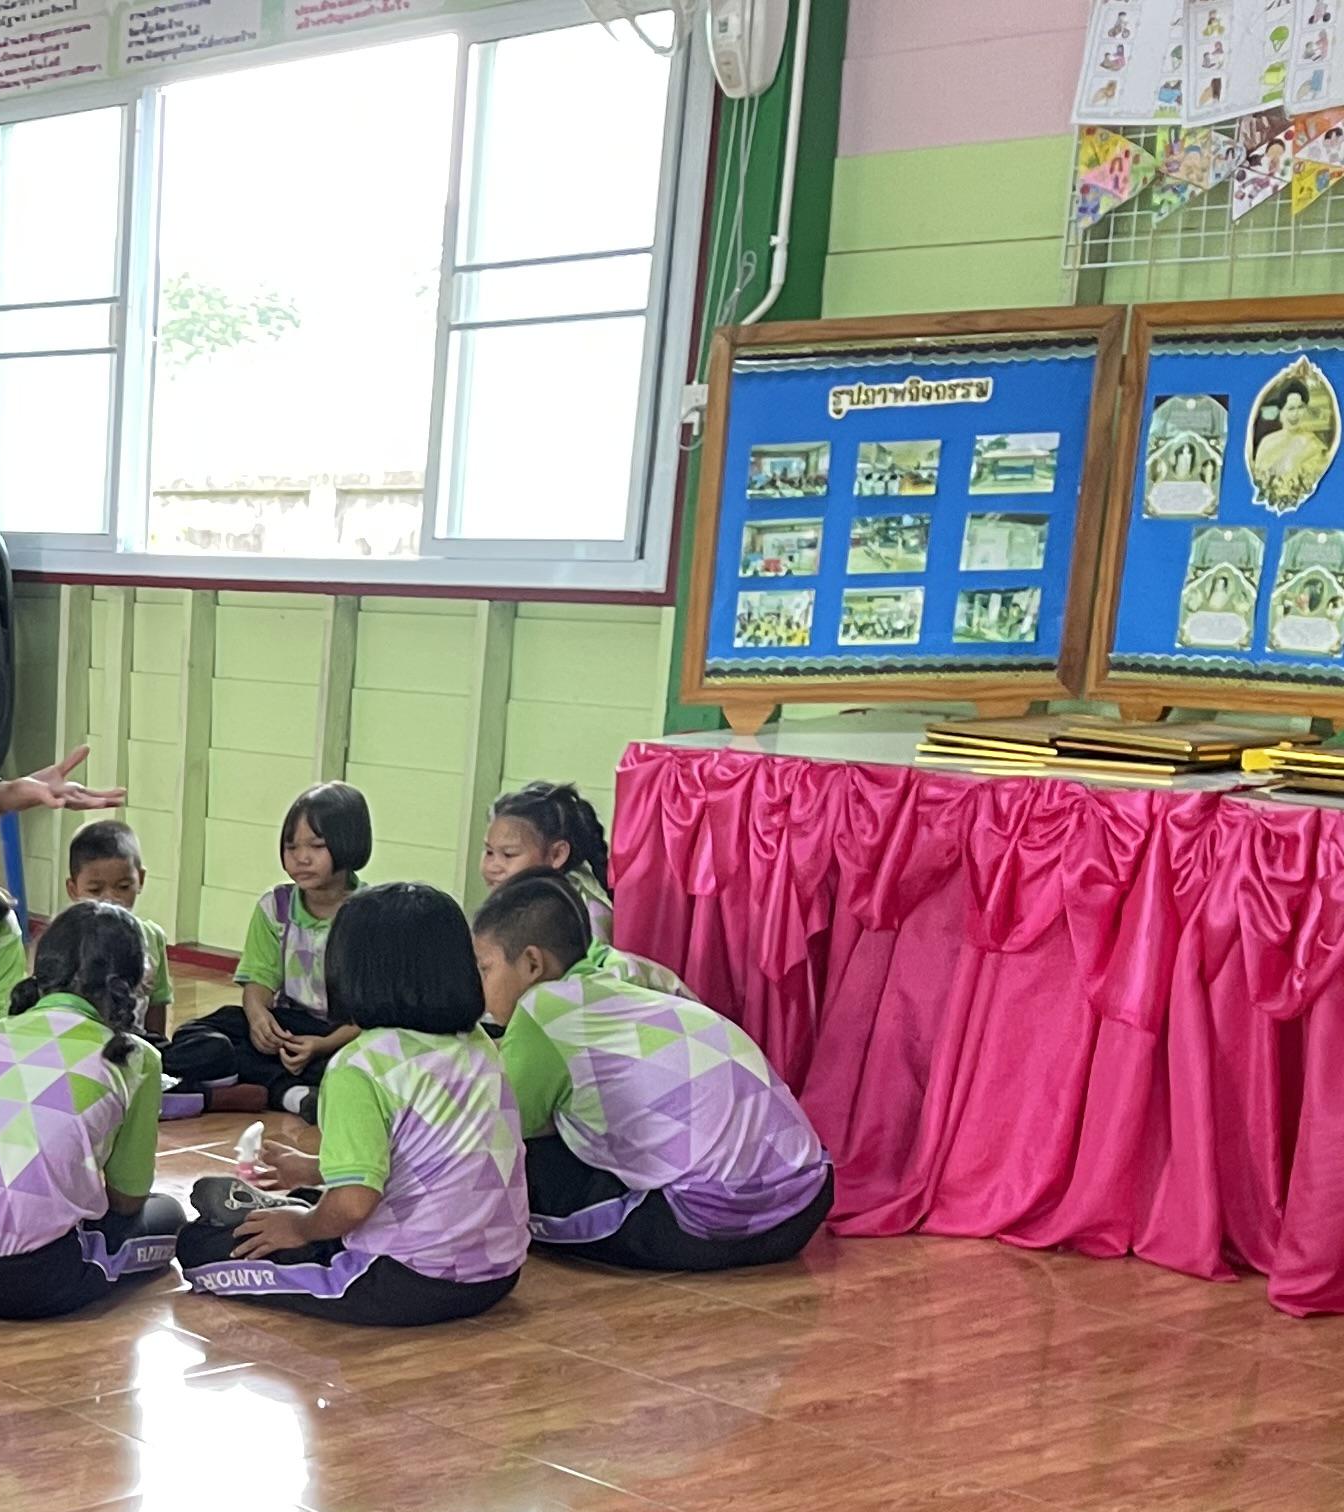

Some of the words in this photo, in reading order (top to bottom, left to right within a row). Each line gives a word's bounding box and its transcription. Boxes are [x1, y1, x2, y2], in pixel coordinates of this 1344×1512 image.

[832, 377, 989, 415] รูปภาพกิจกรรม
